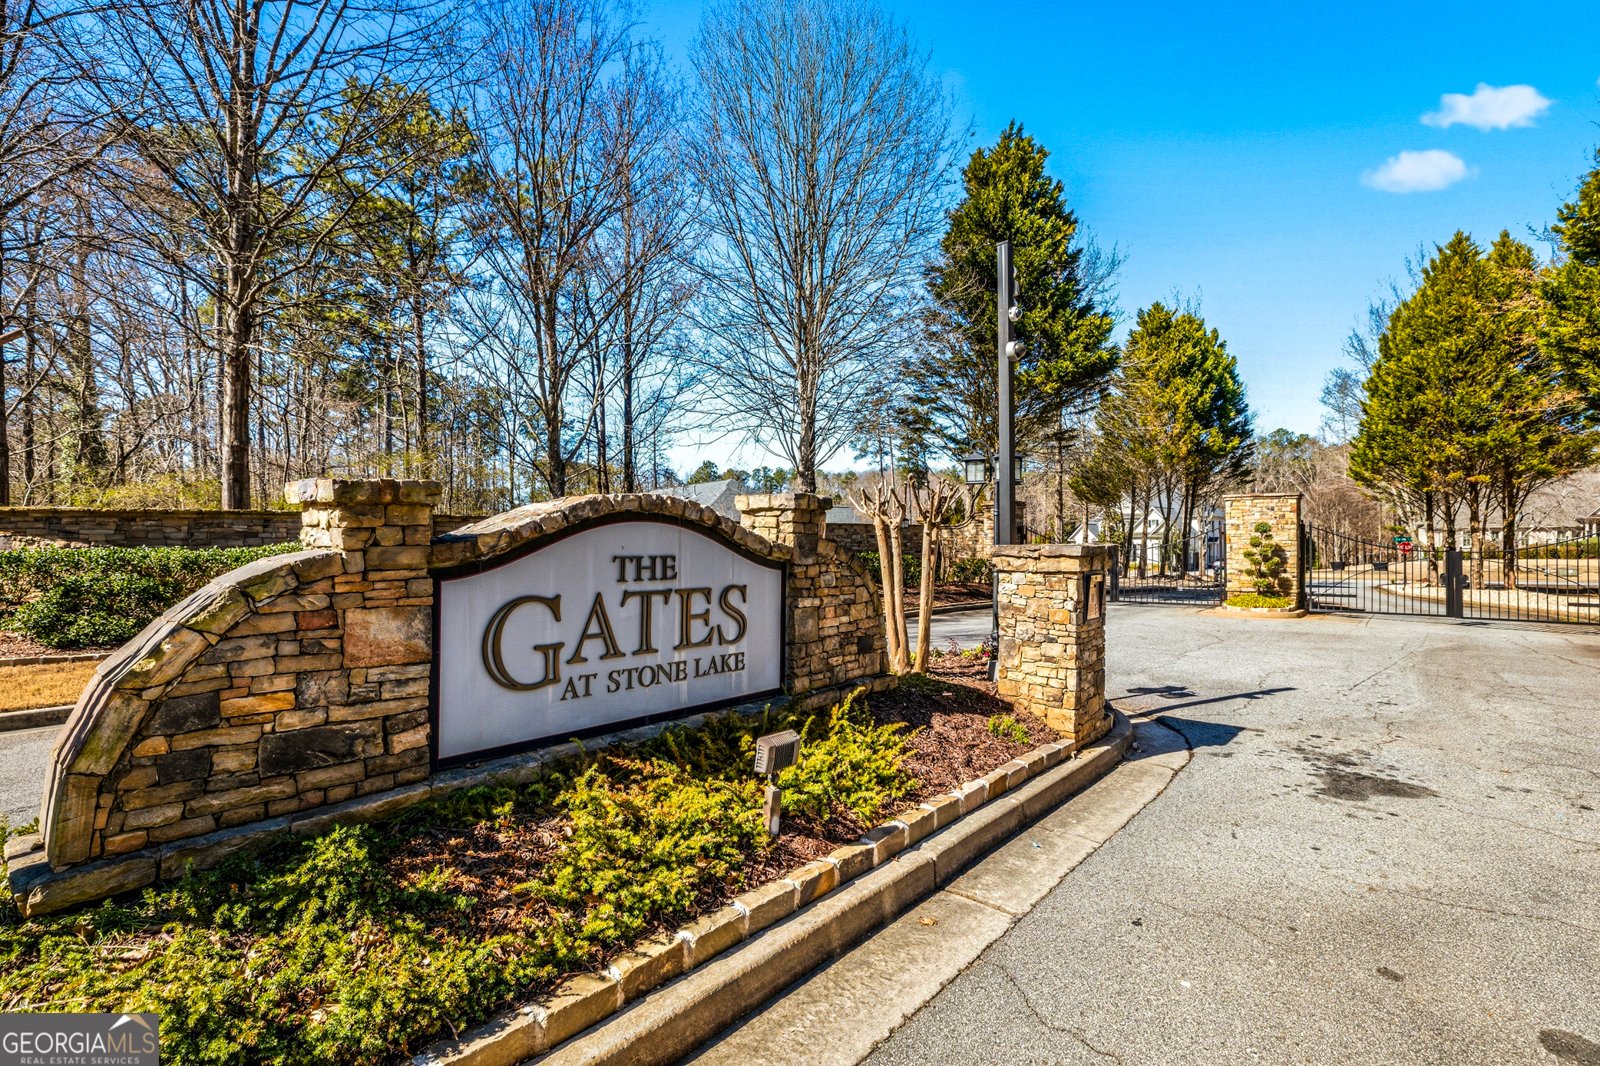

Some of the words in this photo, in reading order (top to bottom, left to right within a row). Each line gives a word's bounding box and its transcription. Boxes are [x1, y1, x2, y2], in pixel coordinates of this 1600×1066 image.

[612, 555, 678, 583] THE
[482, 584, 748, 691] GATES
[560, 673, 598, 701] AT
[607, 660, 688, 693] STONE
[694, 652, 746, 678] LAKE
